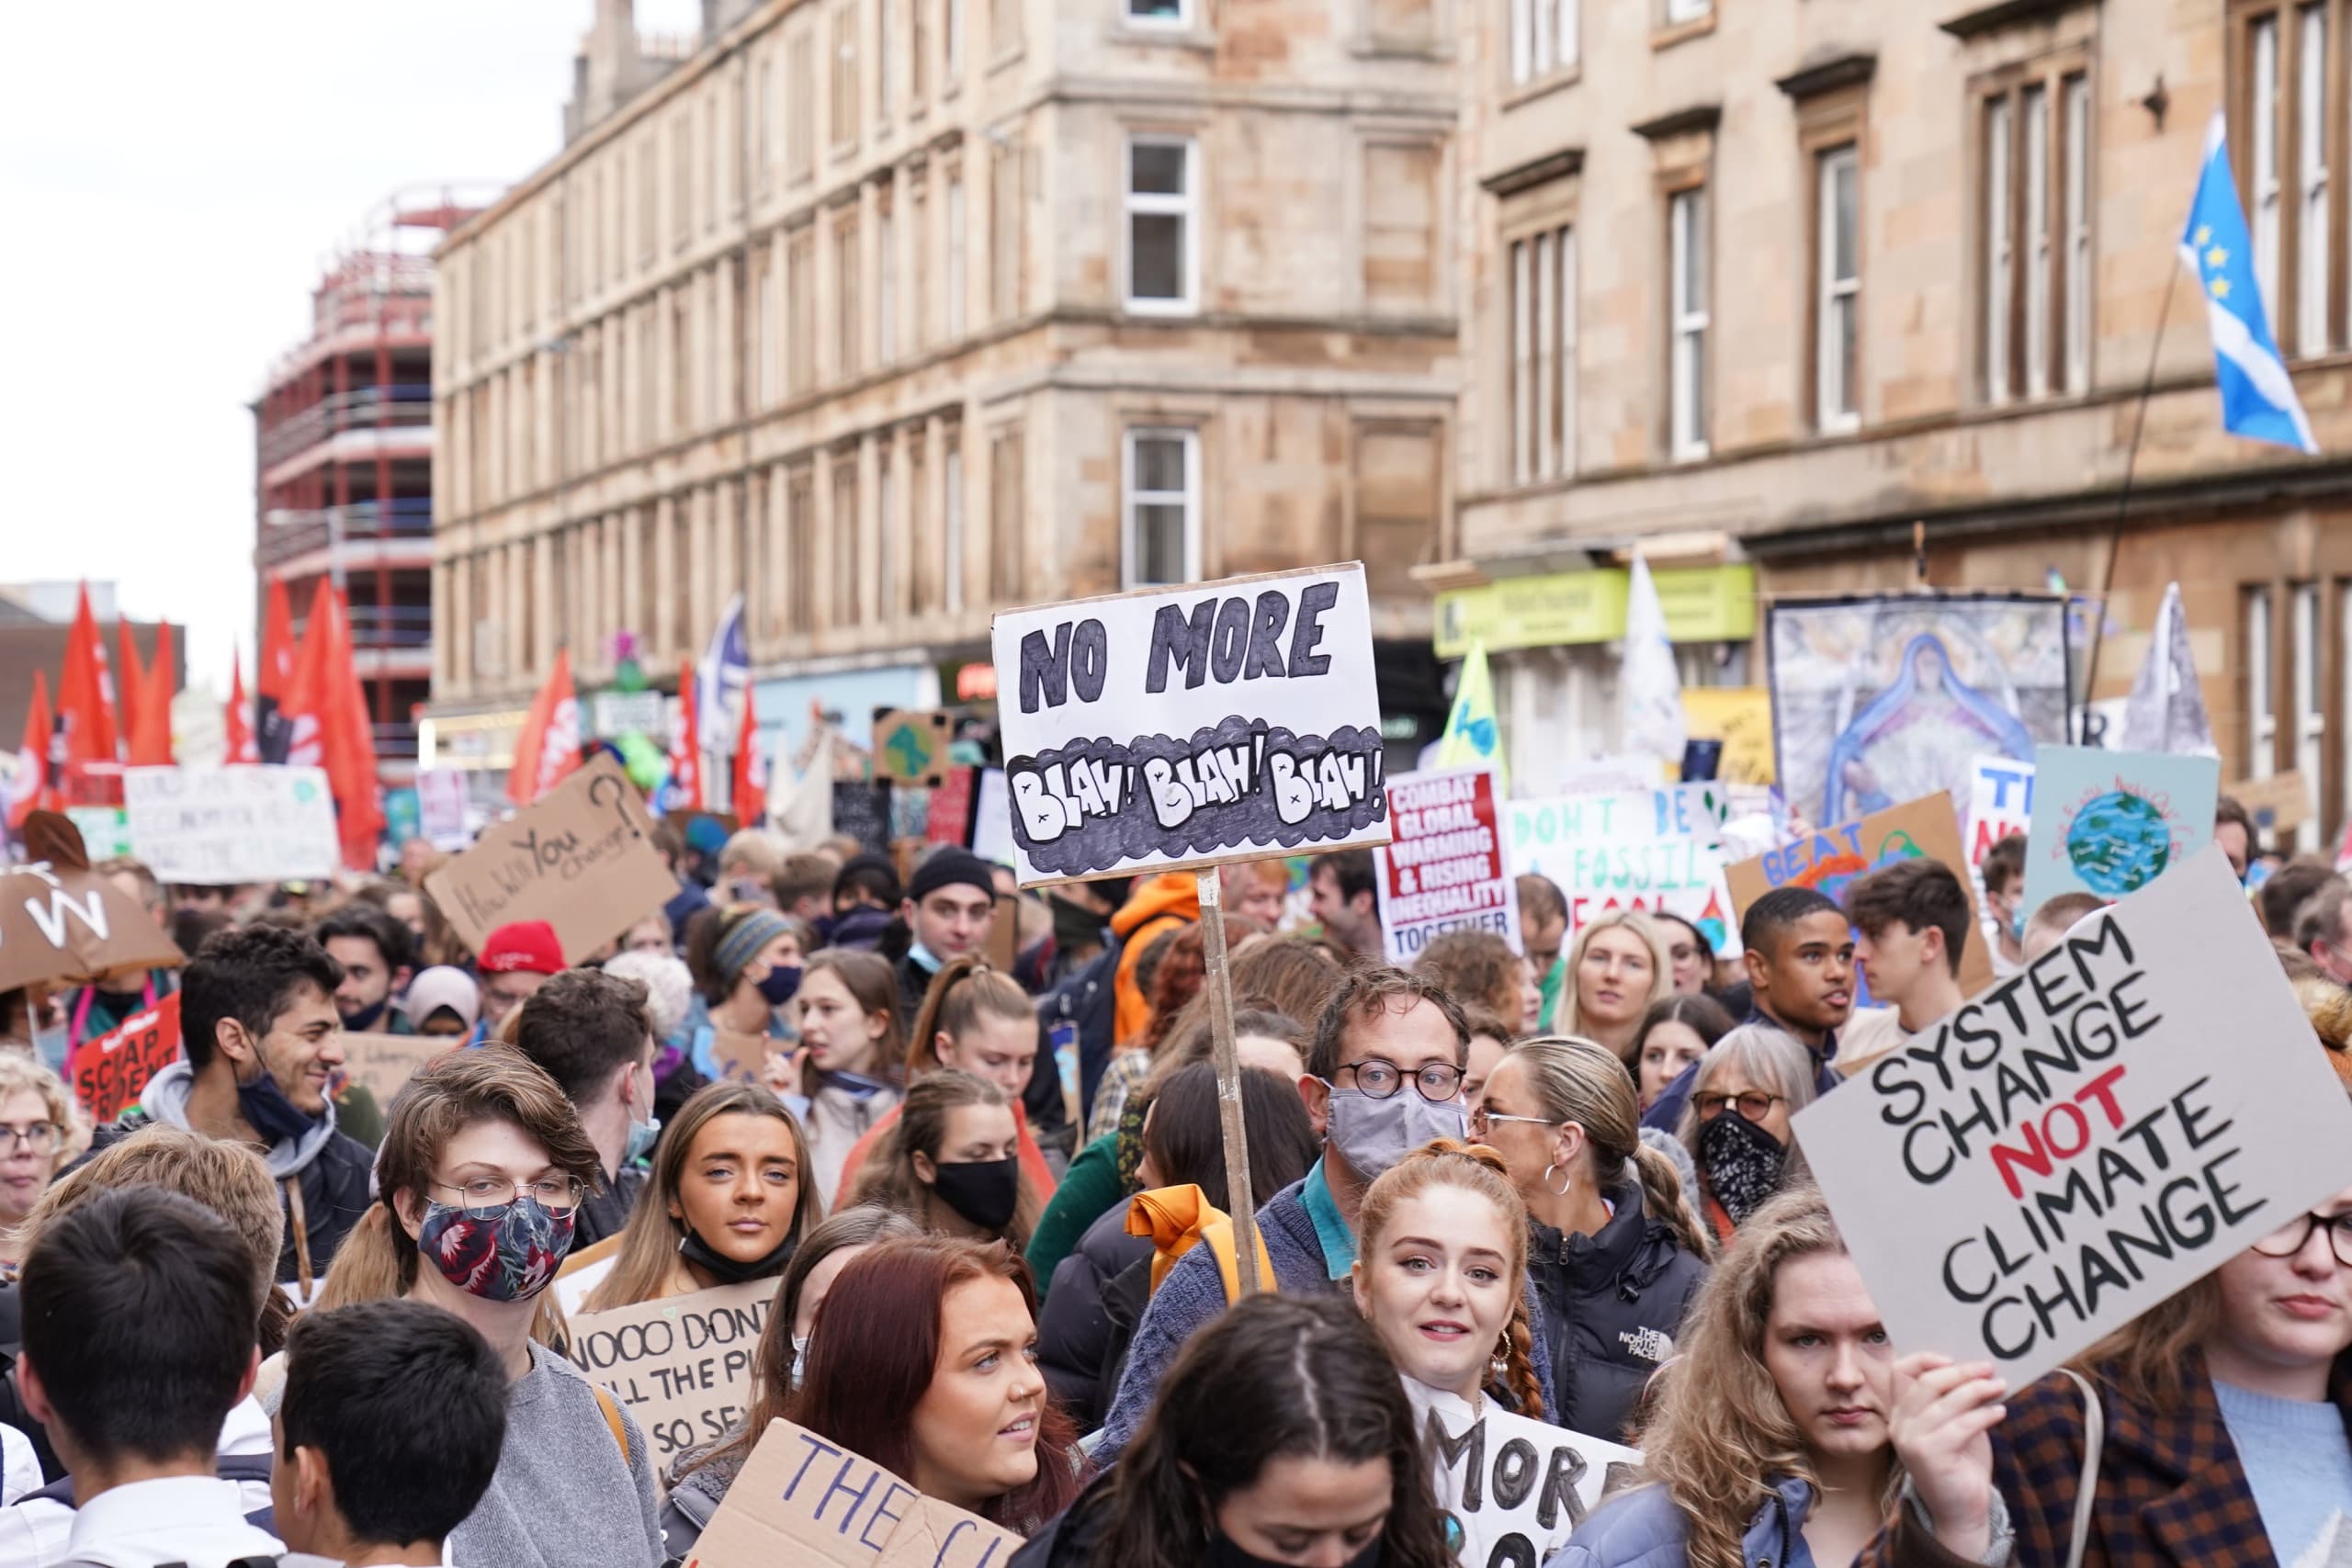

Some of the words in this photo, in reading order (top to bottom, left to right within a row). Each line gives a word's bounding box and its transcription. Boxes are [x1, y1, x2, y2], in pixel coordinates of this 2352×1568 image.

[1021, 619, 1106, 713] NO
[1146, 581, 1339, 693] MORE
[1012, 757, 1135, 842] BLAH!
[1143, 734, 1266, 827] BLAH!
[1271, 748, 1383, 824] BLAH!
[1391, 776, 1476, 814] COMBAT
[1398, 802, 1480, 840] GLOBAL
[1655, 790, 1690, 835] BE
[510, 829, 579, 876] You
[1390, 827, 1492, 869] WARMING
[1574, 840, 1706, 889] FOSSIL
[1762, 823, 1863, 886] BEAT
[1398, 868, 1418, 896] &
[1419, 854, 1491, 891] RISING
[1390, 881, 1506, 924] INEQUALITY
[1872, 914, 2133, 1125] SYSTEM
[1903, 971, 2164, 1184] CHANGE
[1990, 1065, 2126, 1200] NOT
[1941, 1076, 2233, 1303] CLIMATE
[1983, 1147, 2268, 1360] CHANGE
[569, 1320, 673, 1372] NOOO
[1619, 1330, 1657, 1351] NORTH
[1628, 1343, 1656, 1360] FACE
[1637, 1325, 1659, 1342] THE
[650, 1359, 714, 1400] THE
[653, 1419, 694, 1453] SO
[784, 1434, 919, 1553] THE
